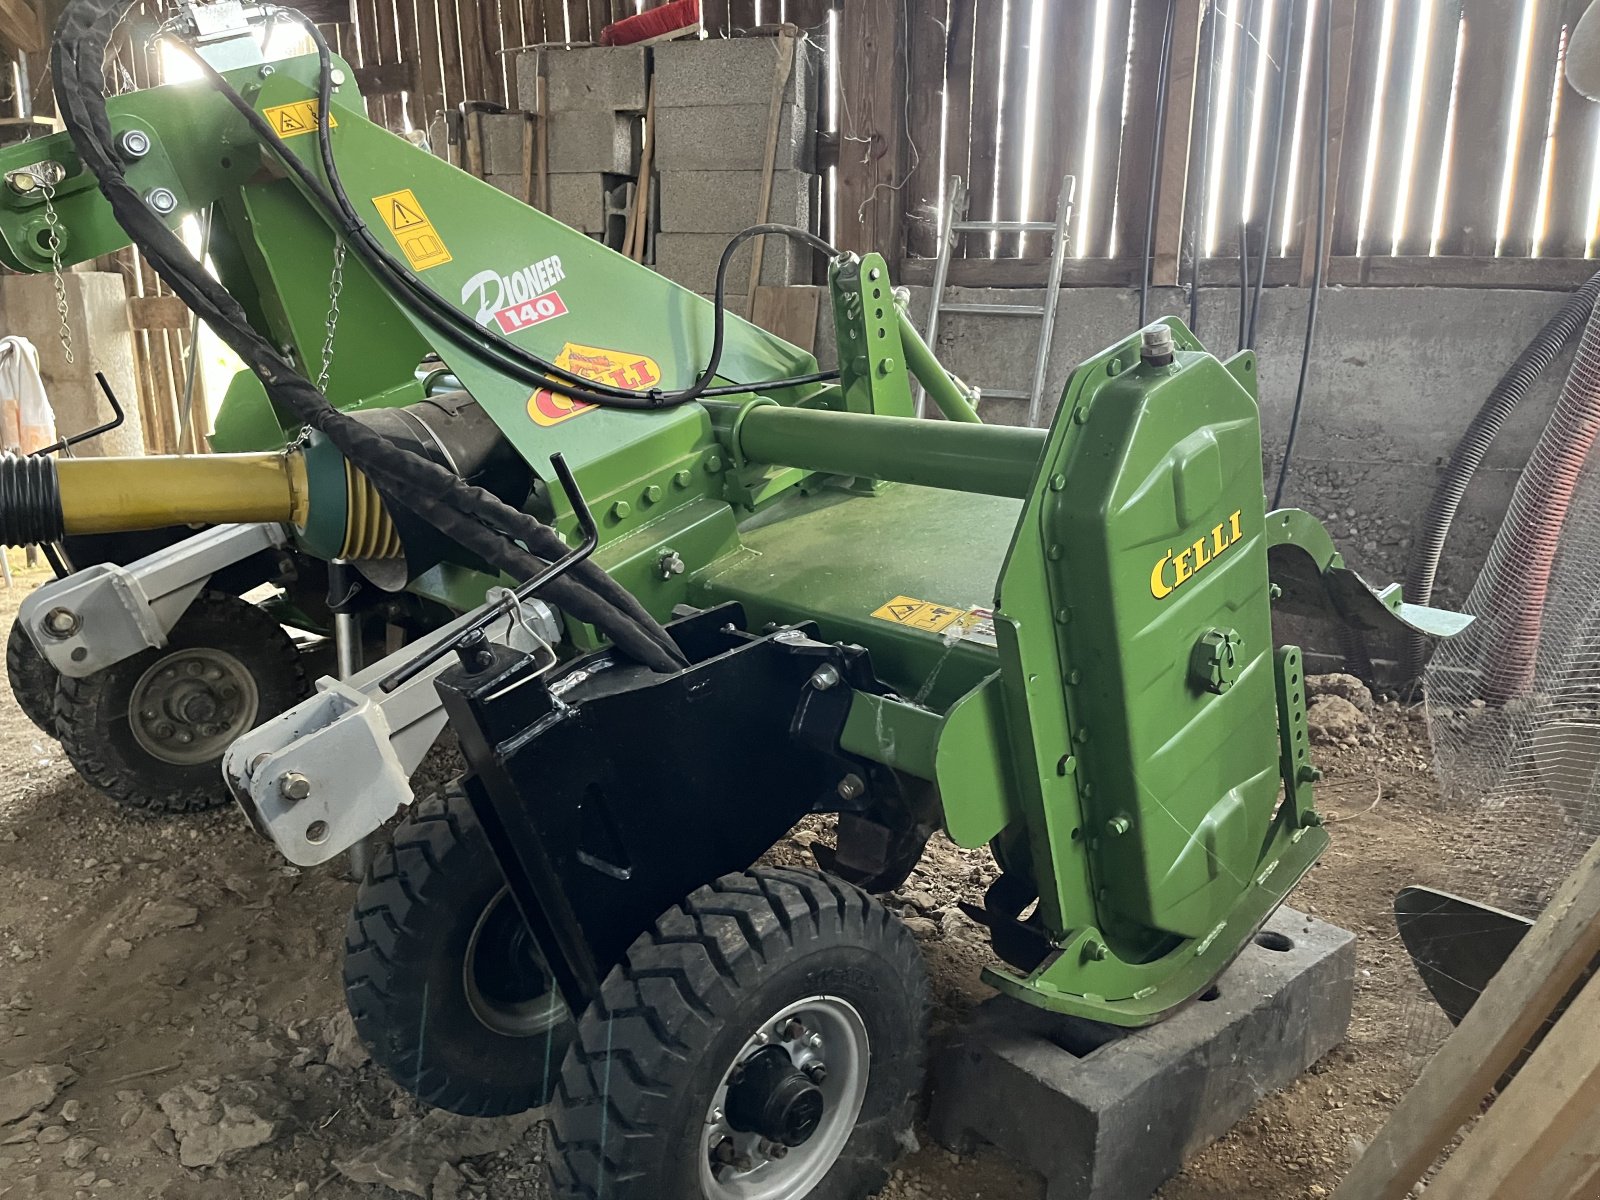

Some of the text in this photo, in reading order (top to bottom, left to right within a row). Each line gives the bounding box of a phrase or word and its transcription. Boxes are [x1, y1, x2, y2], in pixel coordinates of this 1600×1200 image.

[461, 254, 566, 328] PIONEER
[505, 298, 556, 327] 140
[535, 360, 655, 418] CLI
[1150, 509, 1243, 600] CELLI
